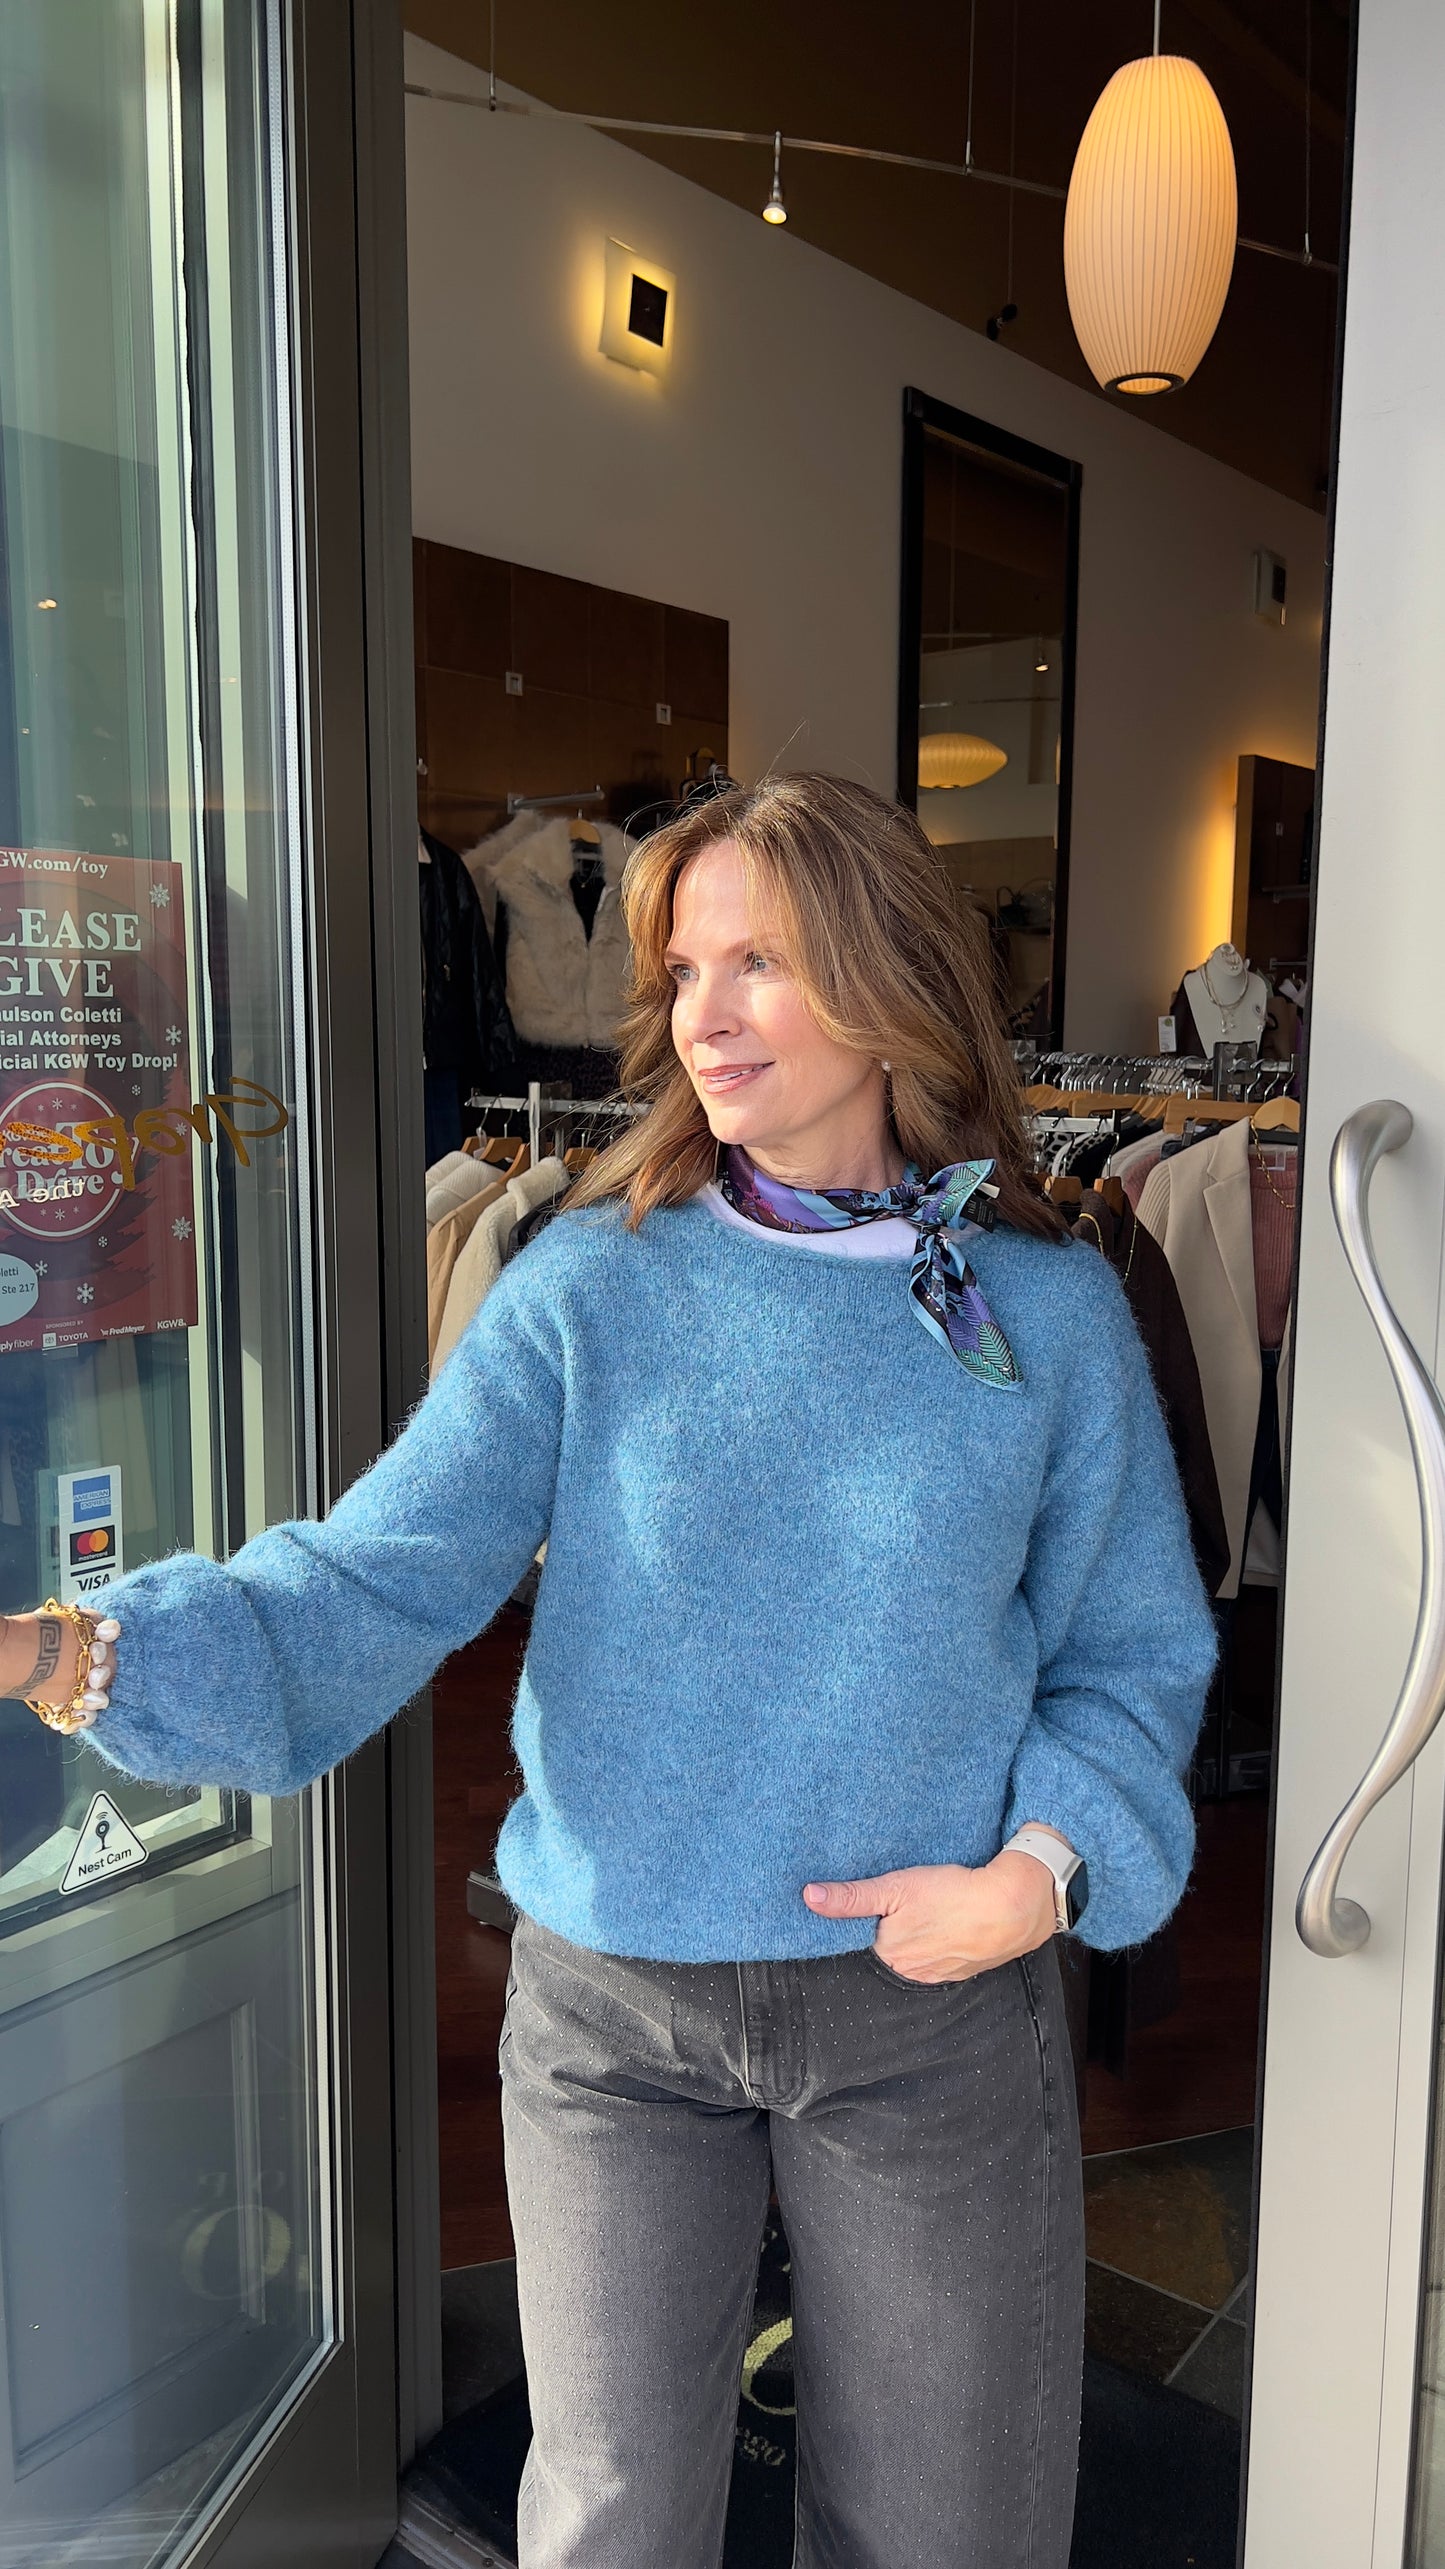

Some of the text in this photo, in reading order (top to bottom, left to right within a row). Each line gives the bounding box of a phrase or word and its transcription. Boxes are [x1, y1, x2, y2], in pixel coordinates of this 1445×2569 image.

[0, 956, 114, 998] GIVE
[0, 1006, 122, 1023] ulson Coletti
[30, 1030, 122, 1050] Attorneys
[44, 1053, 89, 1070] KGW
[94, 1053, 126, 1073] Toy
[131, 1052, 178, 1072] Drop!
[2, 1282, 35, 1295] Ste 217
[14, 1339, 34, 1348] fiber
[58, 1332, 89, 1342] TOYOTA
[73, 1490, 110, 1503] AMERICAN
[80, 1498, 112, 1510] EXPRESS
[76, 1573, 111, 1592] VISA
[78, 1848, 132, 1877] Nest Cam
